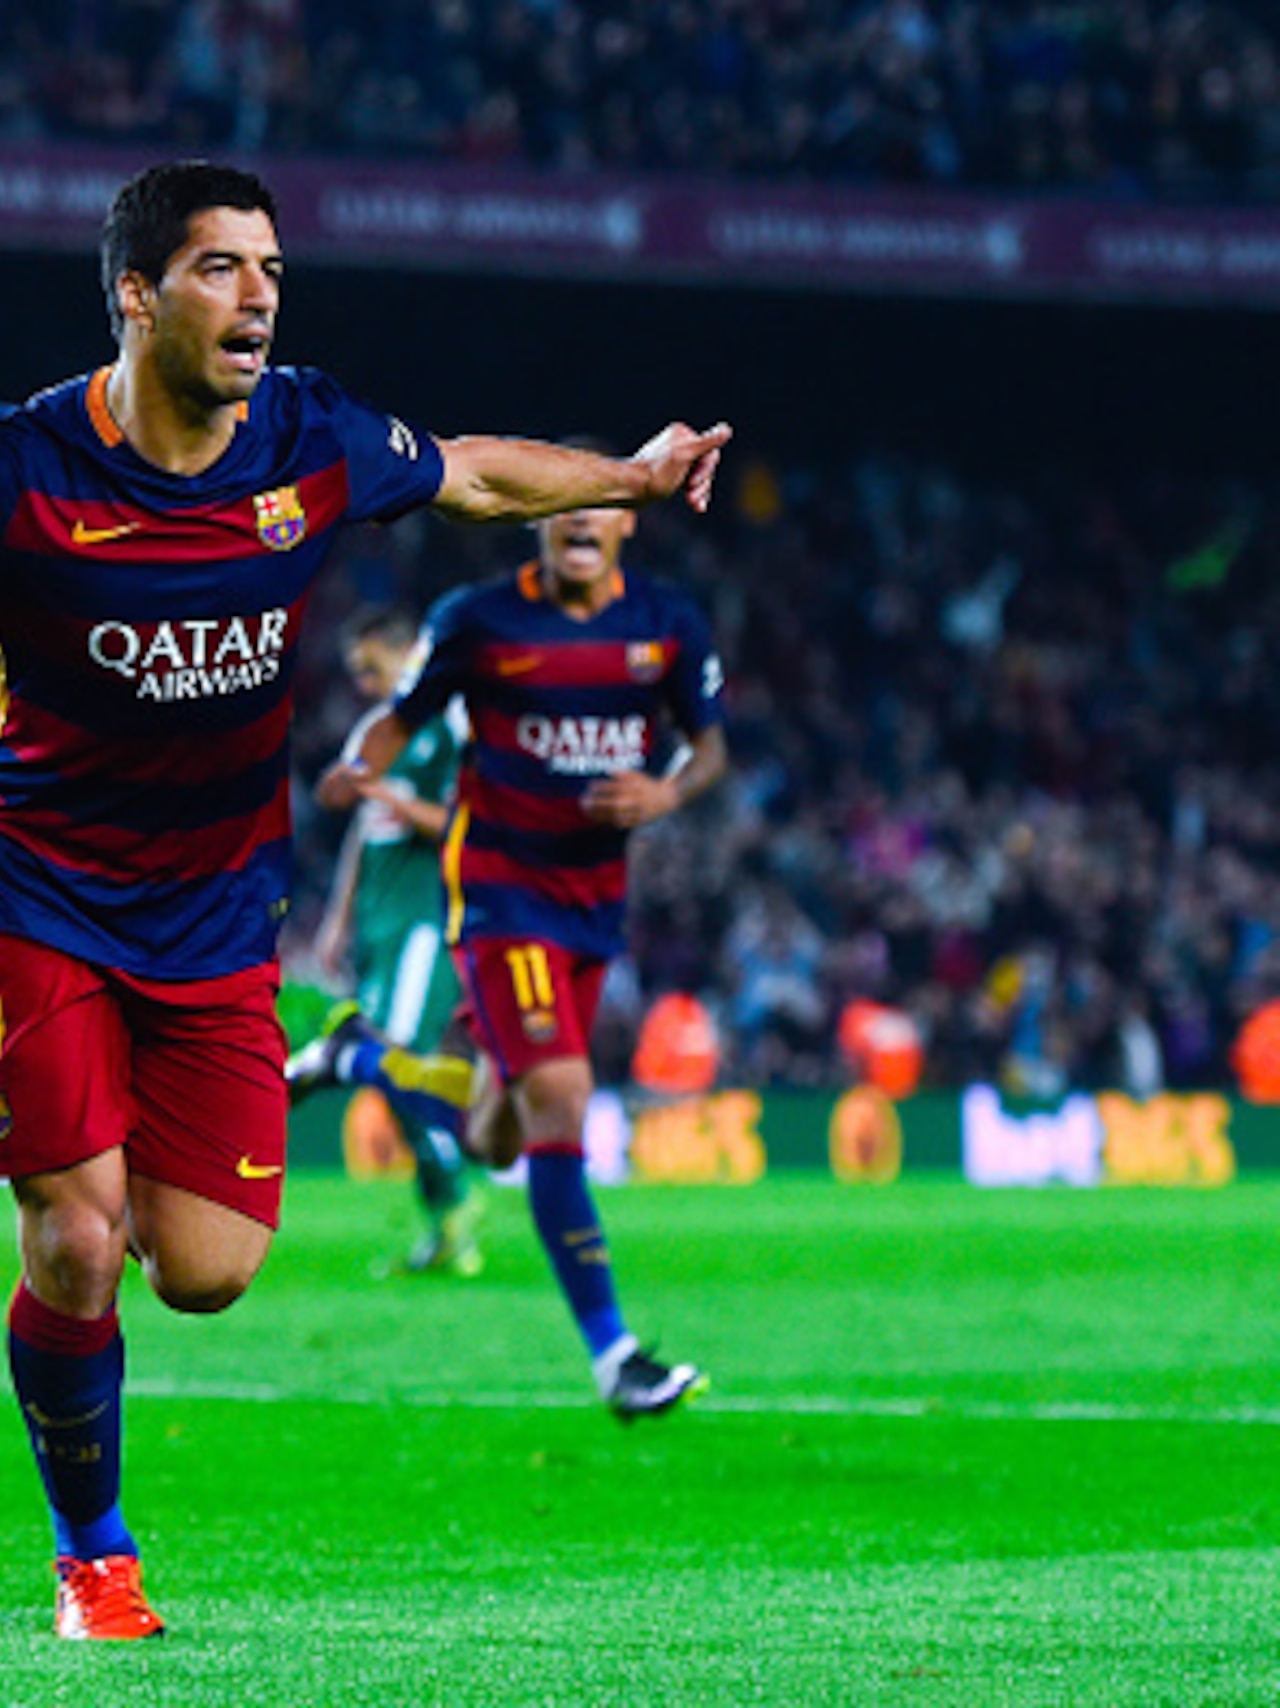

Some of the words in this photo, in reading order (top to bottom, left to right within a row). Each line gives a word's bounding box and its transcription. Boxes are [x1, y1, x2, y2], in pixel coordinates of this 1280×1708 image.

[88, 607, 288, 678] QATAR
[136, 653, 280, 703] AIRWAYS
[517, 713, 646, 759] QATAR
[505, 944, 554, 1010] 11
